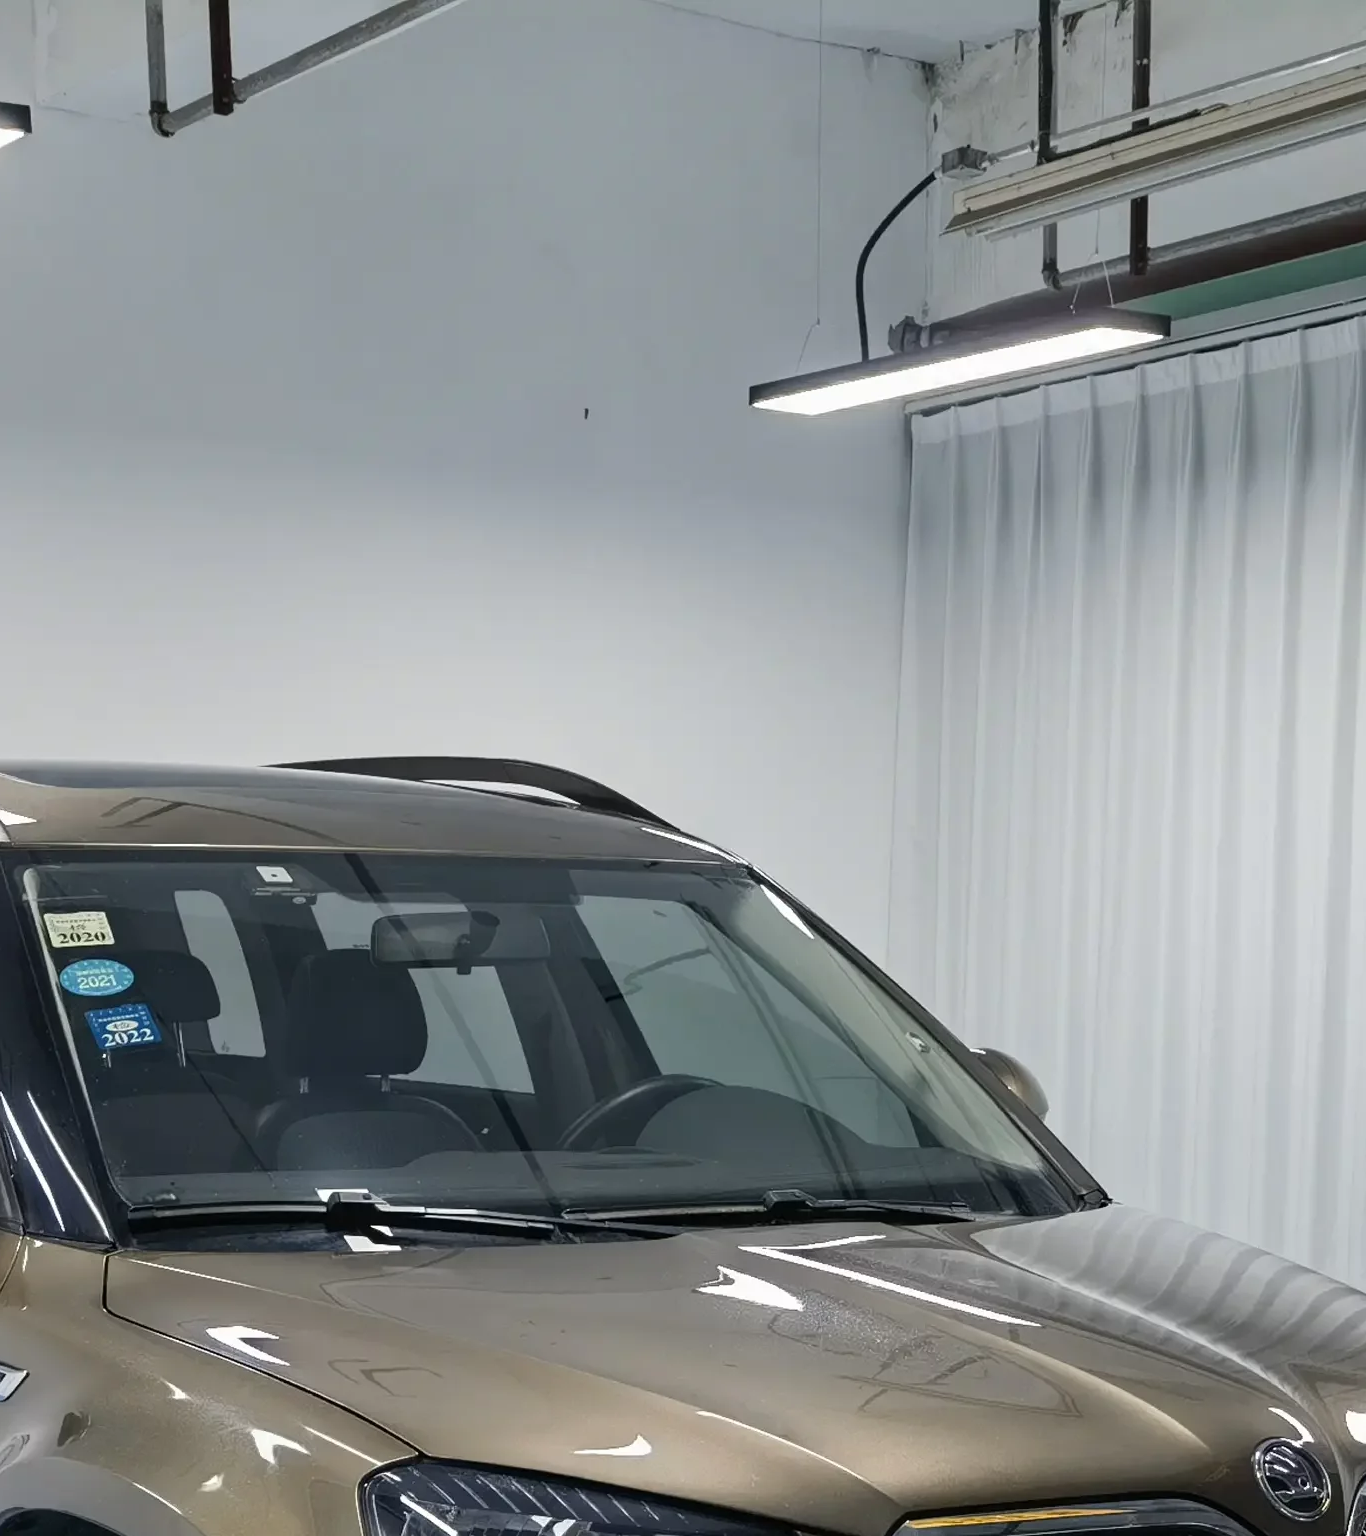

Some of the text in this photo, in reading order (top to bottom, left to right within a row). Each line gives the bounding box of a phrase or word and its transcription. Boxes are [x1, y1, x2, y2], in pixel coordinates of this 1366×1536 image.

[57, 931, 106, 944] 2020
[77, 974, 117, 989] 2021
[101, 1028, 154, 1047] 2022
